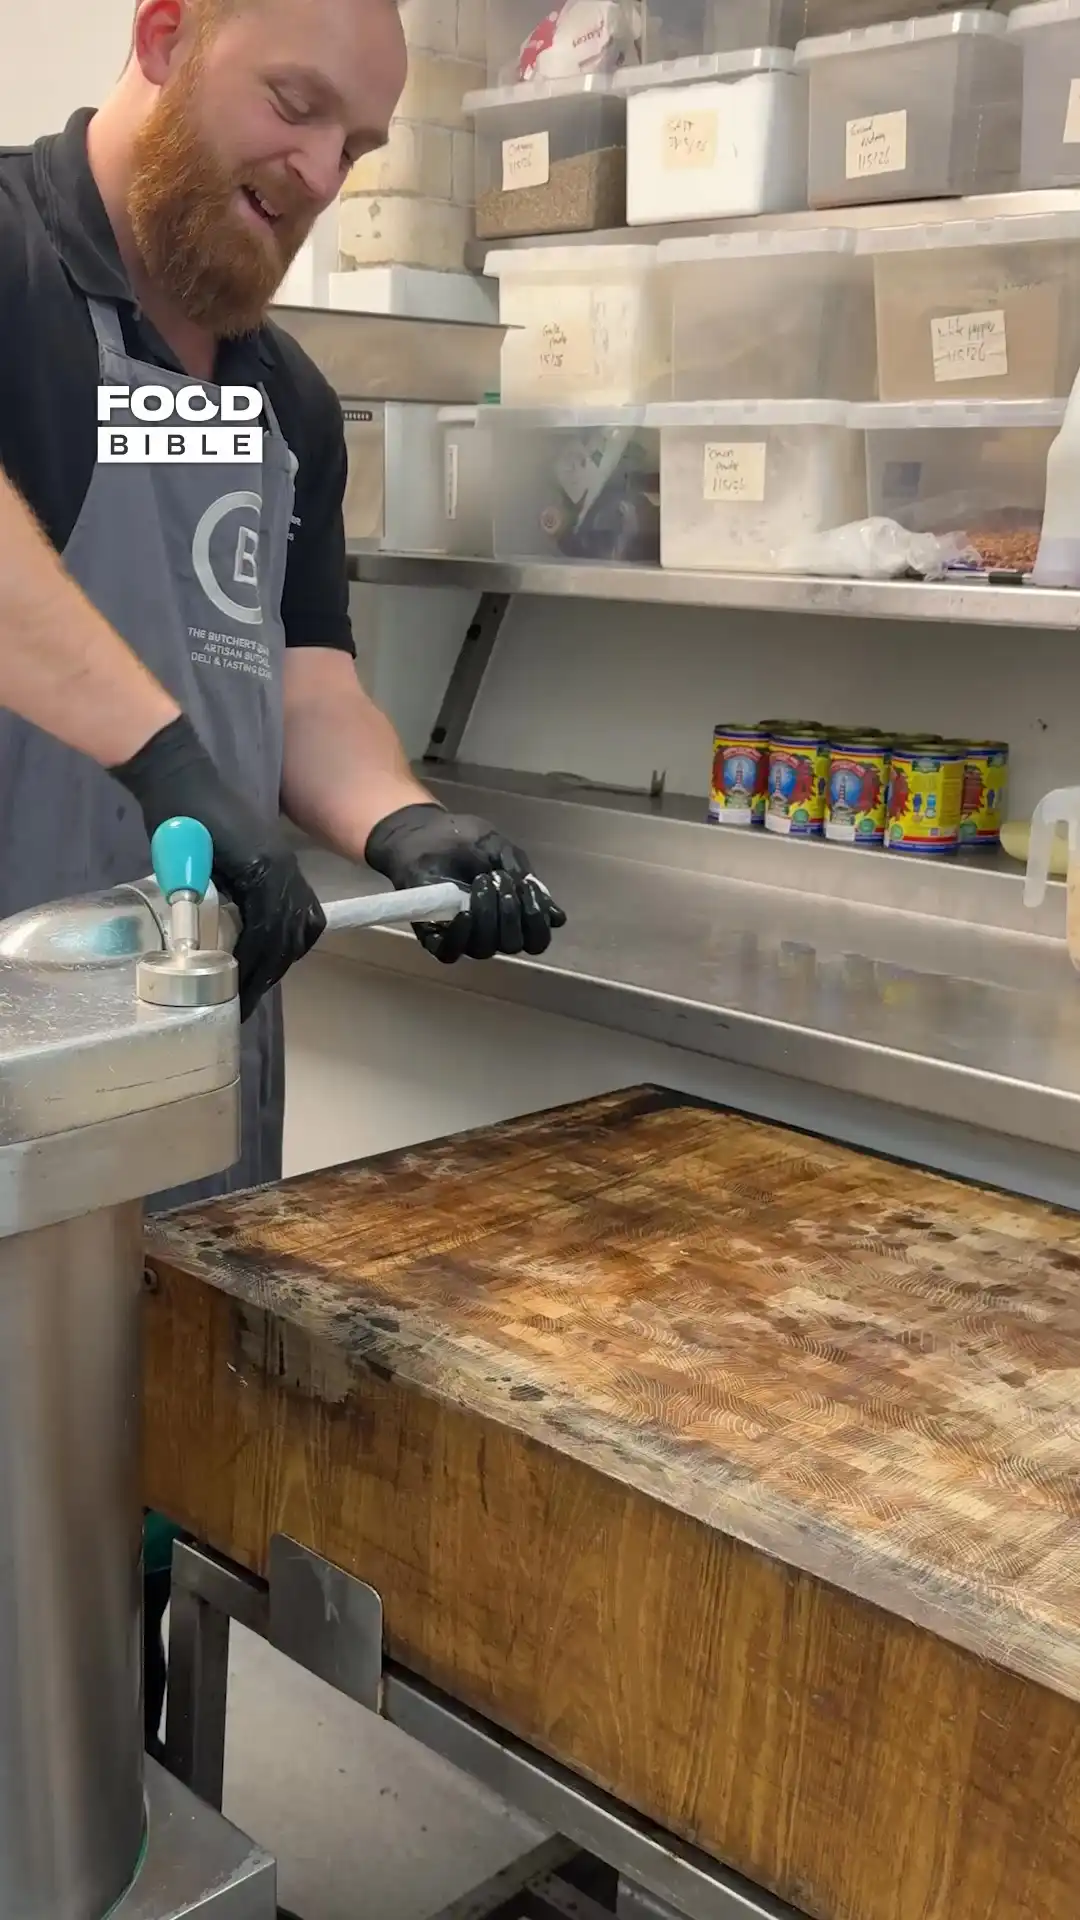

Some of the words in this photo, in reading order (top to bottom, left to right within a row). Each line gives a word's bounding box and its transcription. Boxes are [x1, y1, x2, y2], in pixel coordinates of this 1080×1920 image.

[187, 626, 206, 639] THE
[203, 642, 243, 659] ARTISAN
[191, 651, 212, 664] DELI
[213, 655, 222, 667] &
[222, 657, 258, 674] TASTING
